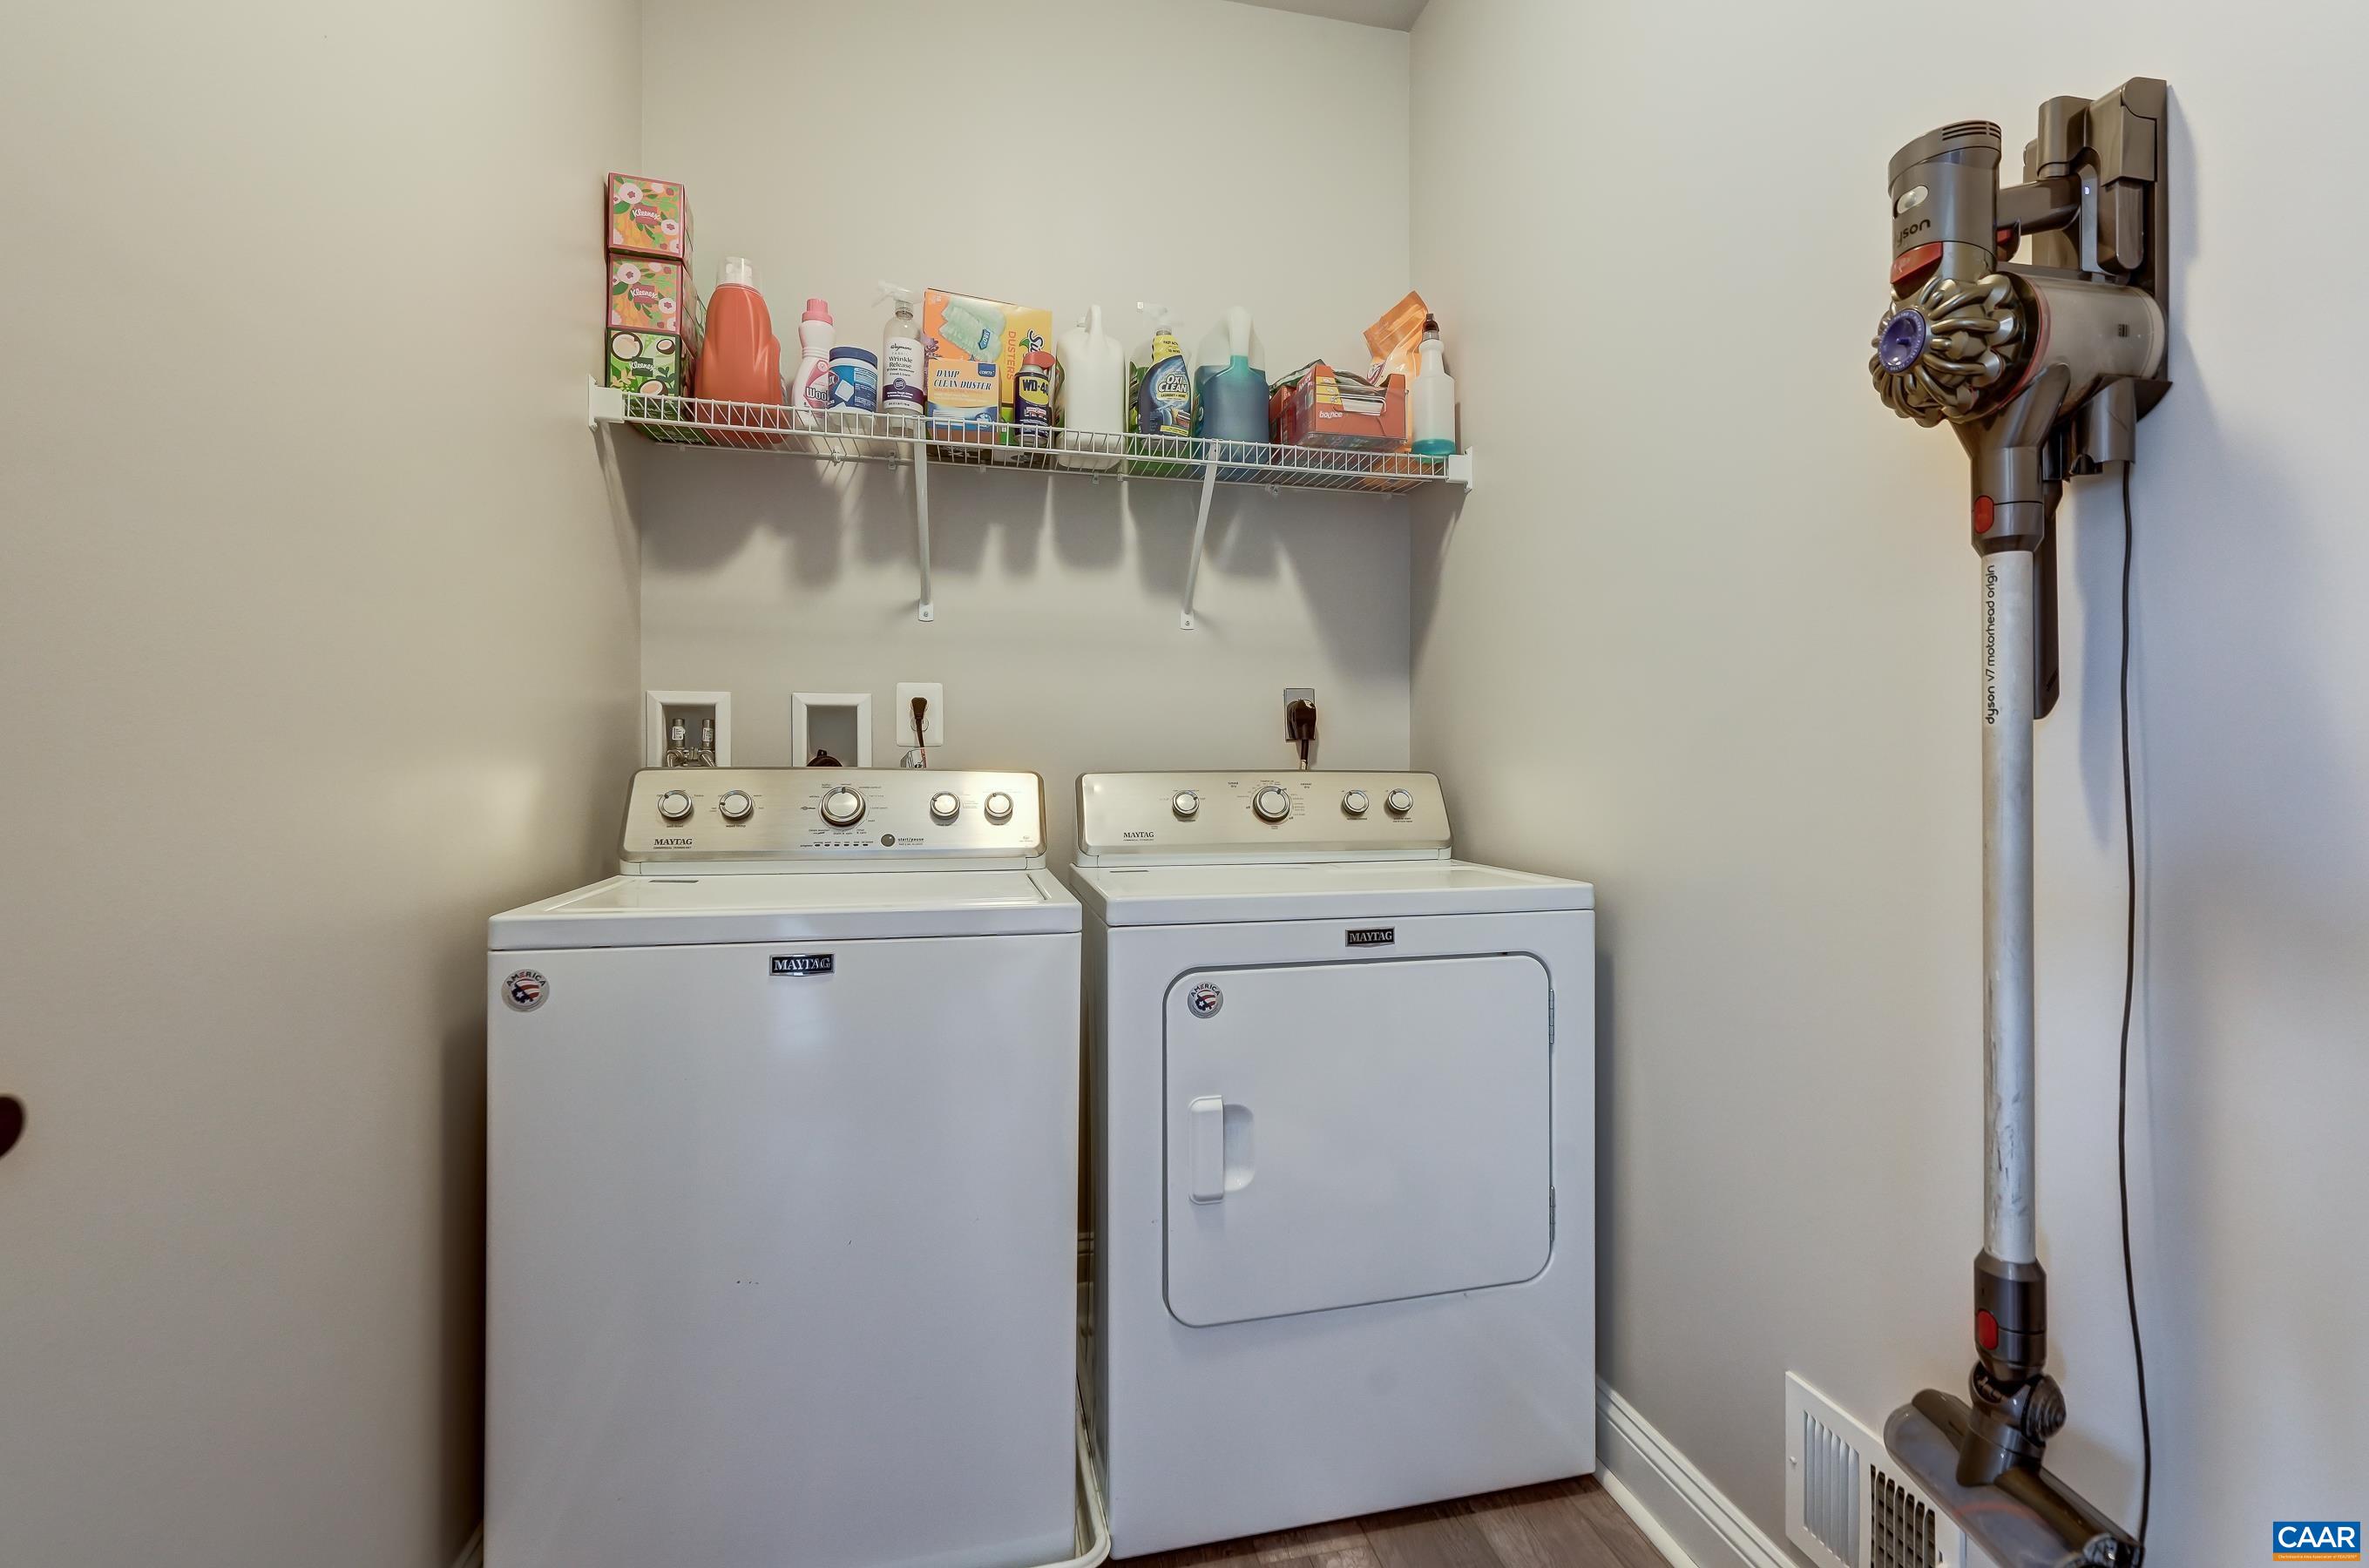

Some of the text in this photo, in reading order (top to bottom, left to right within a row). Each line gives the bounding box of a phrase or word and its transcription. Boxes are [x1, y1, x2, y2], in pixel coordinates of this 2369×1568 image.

[632, 208, 660, 220] Kleenex
[1896, 219, 1931, 248] yson
[630, 287, 659, 299] Kleenex
[1006, 330, 1017, 381] DUSTERS
[629, 360, 656, 372] Kleenex
[936, 369, 960, 378] DAMP
[1166, 374, 1183, 384] OXI
[933, 379, 992, 390] CLEAN DUSTER
[1158, 382, 1188, 393] CLEAN
[1985, 564, 1998, 598] origin
[1985, 600, 1995, 666] motorhead
[1985, 686, 1999, 725] dyson
[1349, 930, 1393, 943] MAYTAG
[773, 957, 832, 972] MAYTAG
[506, 970, 547, 987] AMERICA
[1190, 983, 1221, 997] AMERICA
